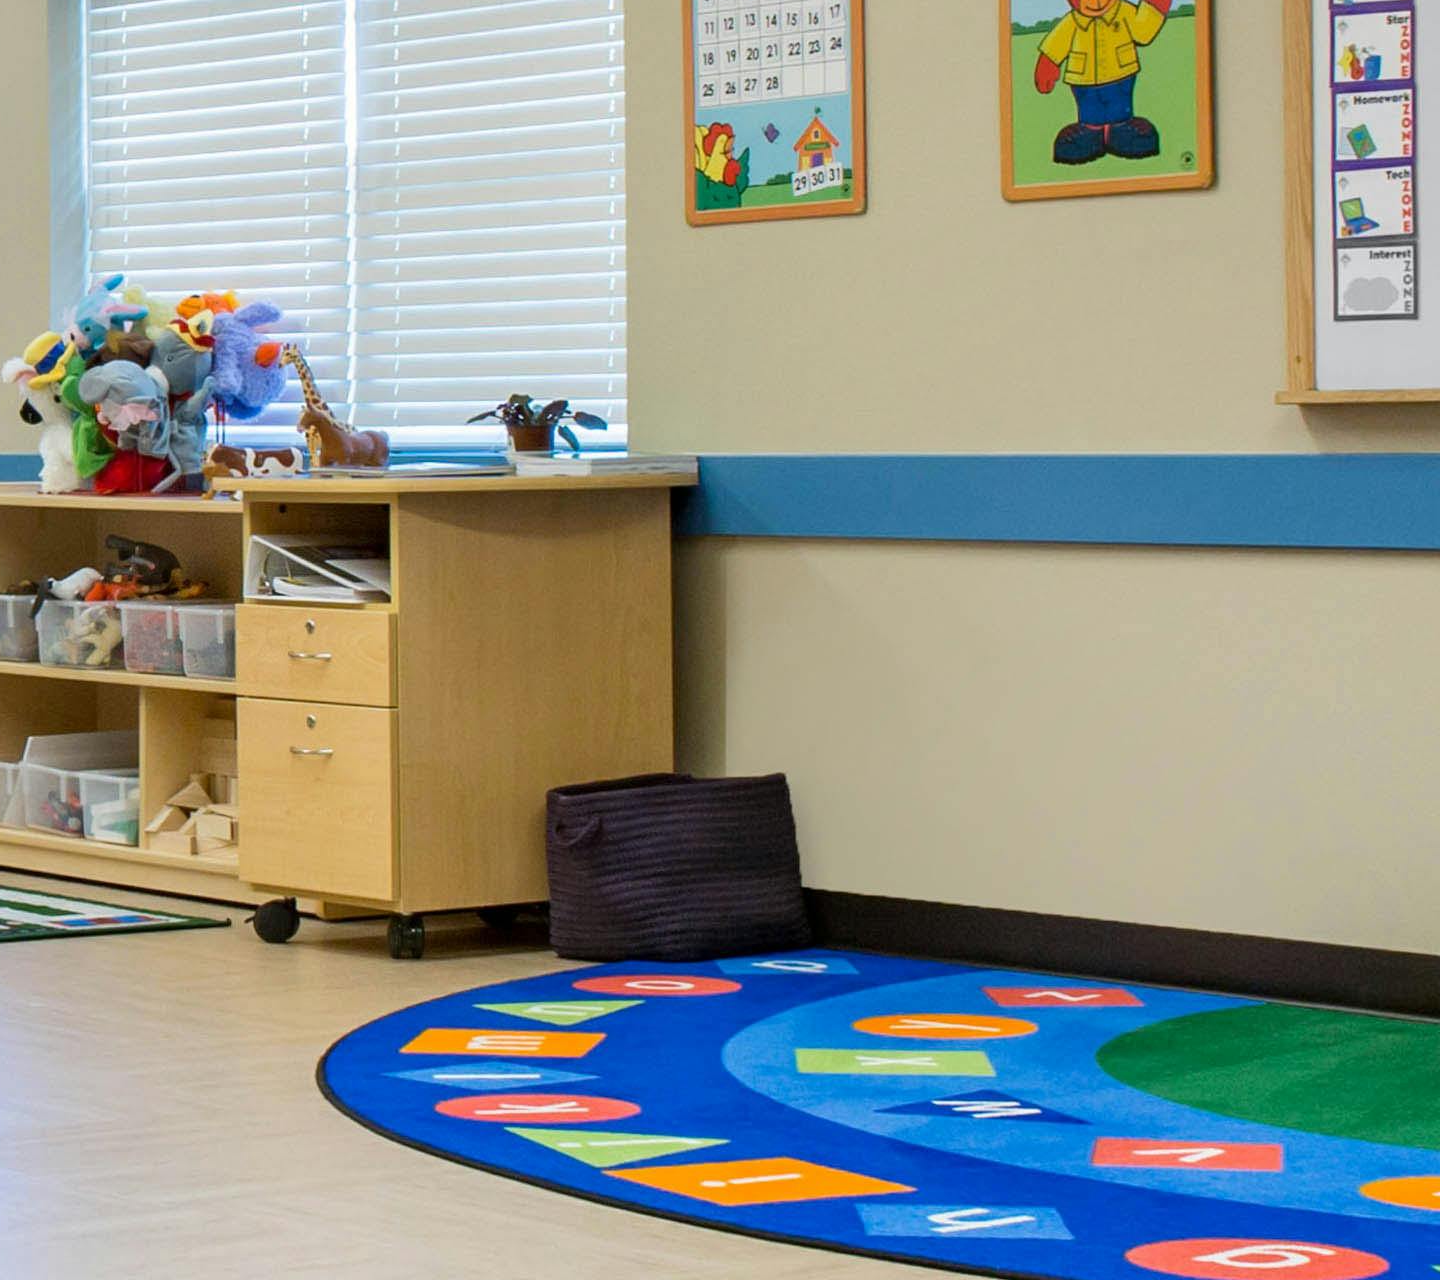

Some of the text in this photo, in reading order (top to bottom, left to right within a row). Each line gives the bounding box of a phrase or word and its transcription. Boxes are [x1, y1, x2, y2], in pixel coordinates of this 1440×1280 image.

[704, 4, 841, 34] 11 12 13 14 15 16 17
[1386, 15, 1409, 25] Star
[703, 37, 843, 65] 18 19 20 21 22 23 24
[1401, 25, 1409, 77] ZONE
[702, 77, 779, 96] 25 26 27 28
[1354, 93, 1409, 105] Homework
[1402, 103, 1410, 155] ZONE
[794, 168, 841, 192] 29 30 31
[1386, 169, 1409, 180] Tech
[1402, 180, 1411, 232] ZONE
[1369, 250, 1411, 260] Interest
[1403, 260, 1412, 312] ZONE
[626, 980, 694, 990] o
[467, 1035, 546, 1052] m
[856, 1056, 939, 1067] x
[474, 1101, 590, 1115] k
[558, 1137, 699, 1148] j
[1132, 1147, 1226, 1163] v
[700, 1173, 802, 1188] i
[1193, 1245, 1337, 1269] g
